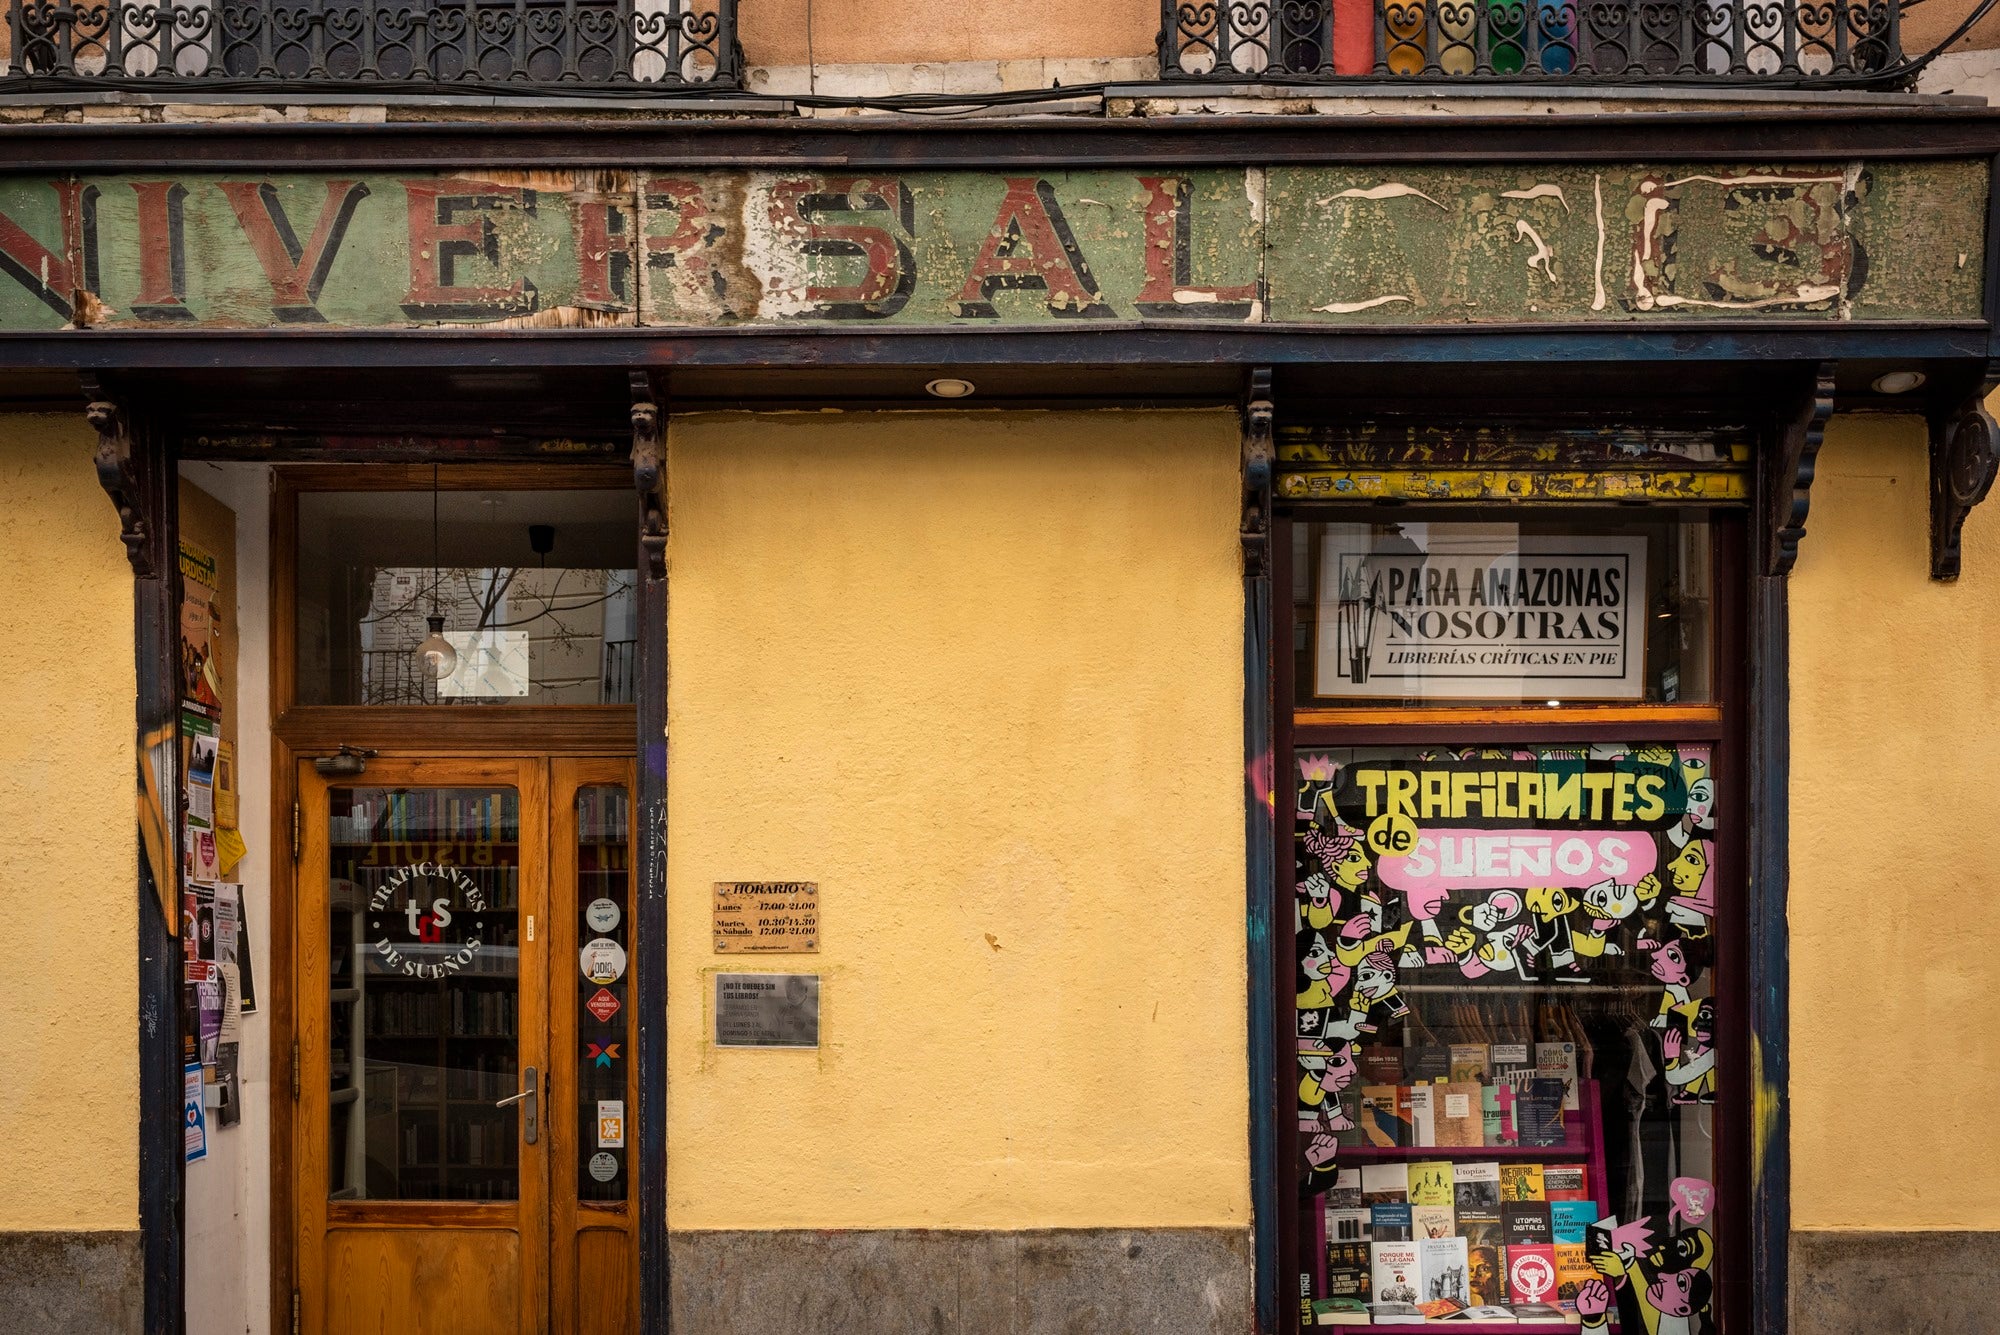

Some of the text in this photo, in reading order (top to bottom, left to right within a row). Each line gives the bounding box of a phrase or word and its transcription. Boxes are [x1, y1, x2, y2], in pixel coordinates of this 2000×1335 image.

[1389, 567, 1621, 607] PARA AMAZONAS
[1386, 610, 1620, 640] NOSOTRAS
[1388, 649, 1618, 666] LIBRERÍAS CRÍTICAS EN PIE
[1373, 816, 1411, 852] de
[1403, 836, 1631, 878] SUEÑOS
[369, 861, 487, 913] TRAFICANTES
[734, 884, 799, 895] HORARIO
[723, 927, 753, 935] Sábado
[375, 936, 481, 979] DE SUEÑOS
[742, 983, 765, 991] QUEDES
